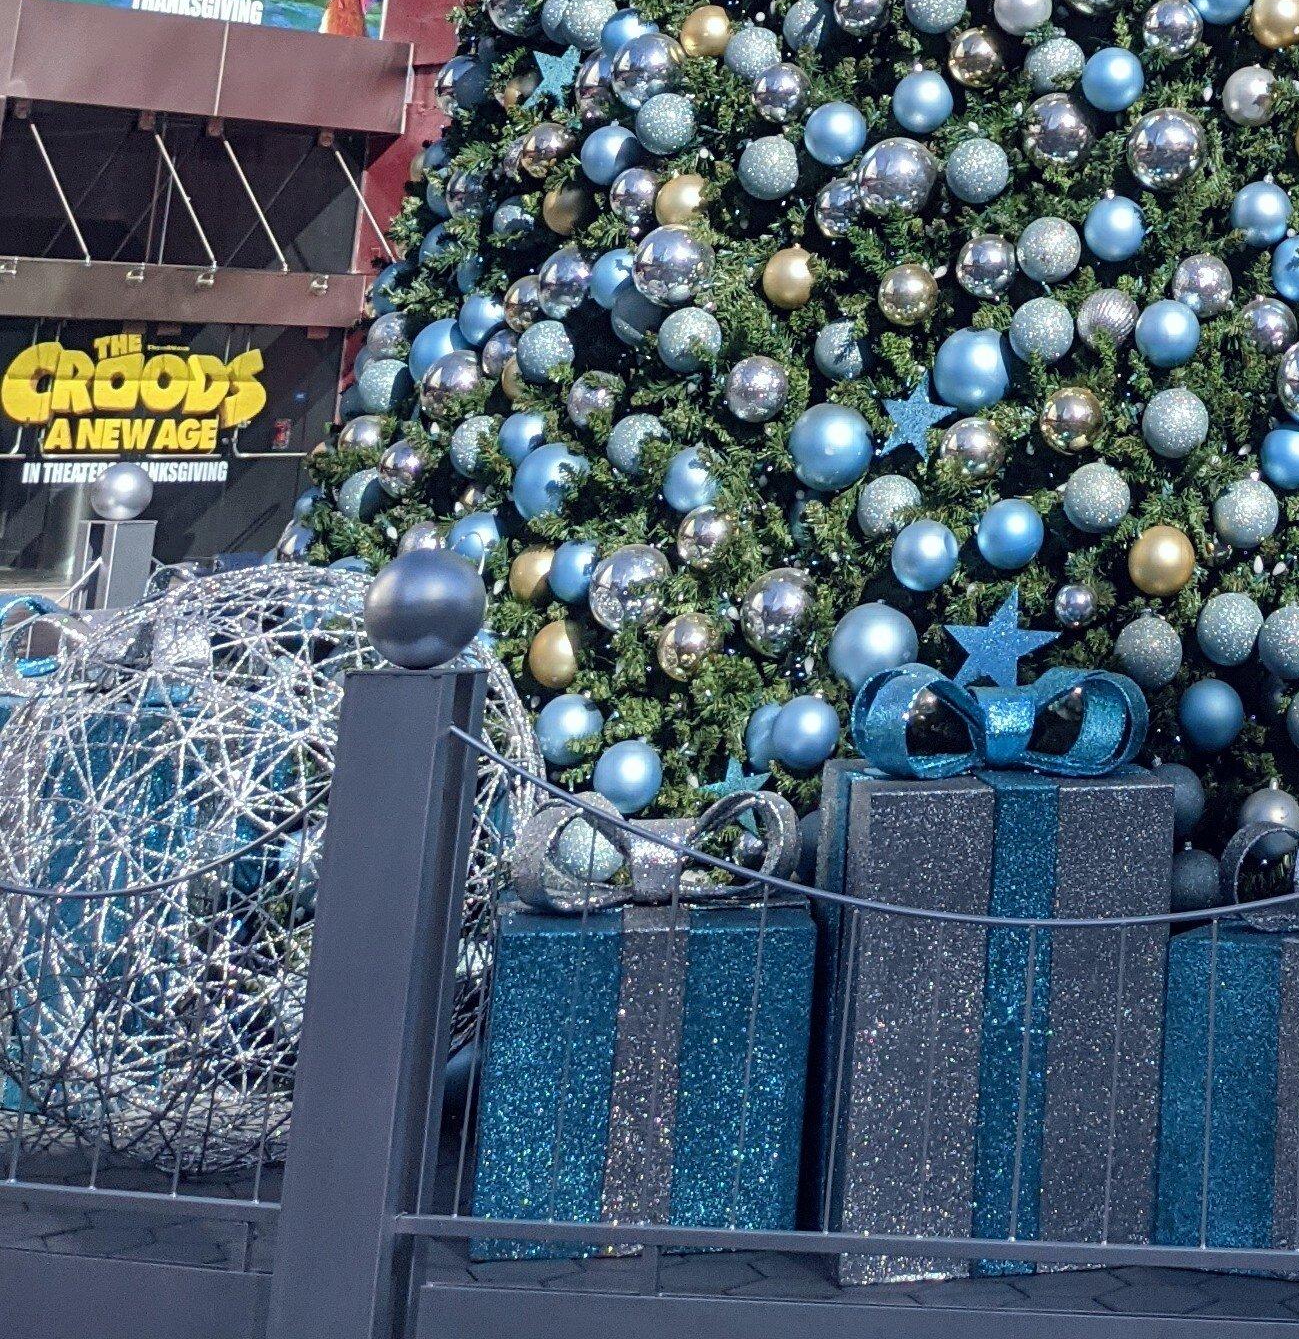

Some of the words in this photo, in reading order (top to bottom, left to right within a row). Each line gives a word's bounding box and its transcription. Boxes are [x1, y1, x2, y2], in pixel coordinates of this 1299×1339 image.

[94, 334, 142, 359] THE
[1, 341, 267, 429] CROODS
[44, 418, 73, 451] A
[76, 418, 155, 451] NEW
[152, 418, 219, 452] AGE
[22, 461, 42, 484] IN
[43, 461, 117, 483] THEATER
